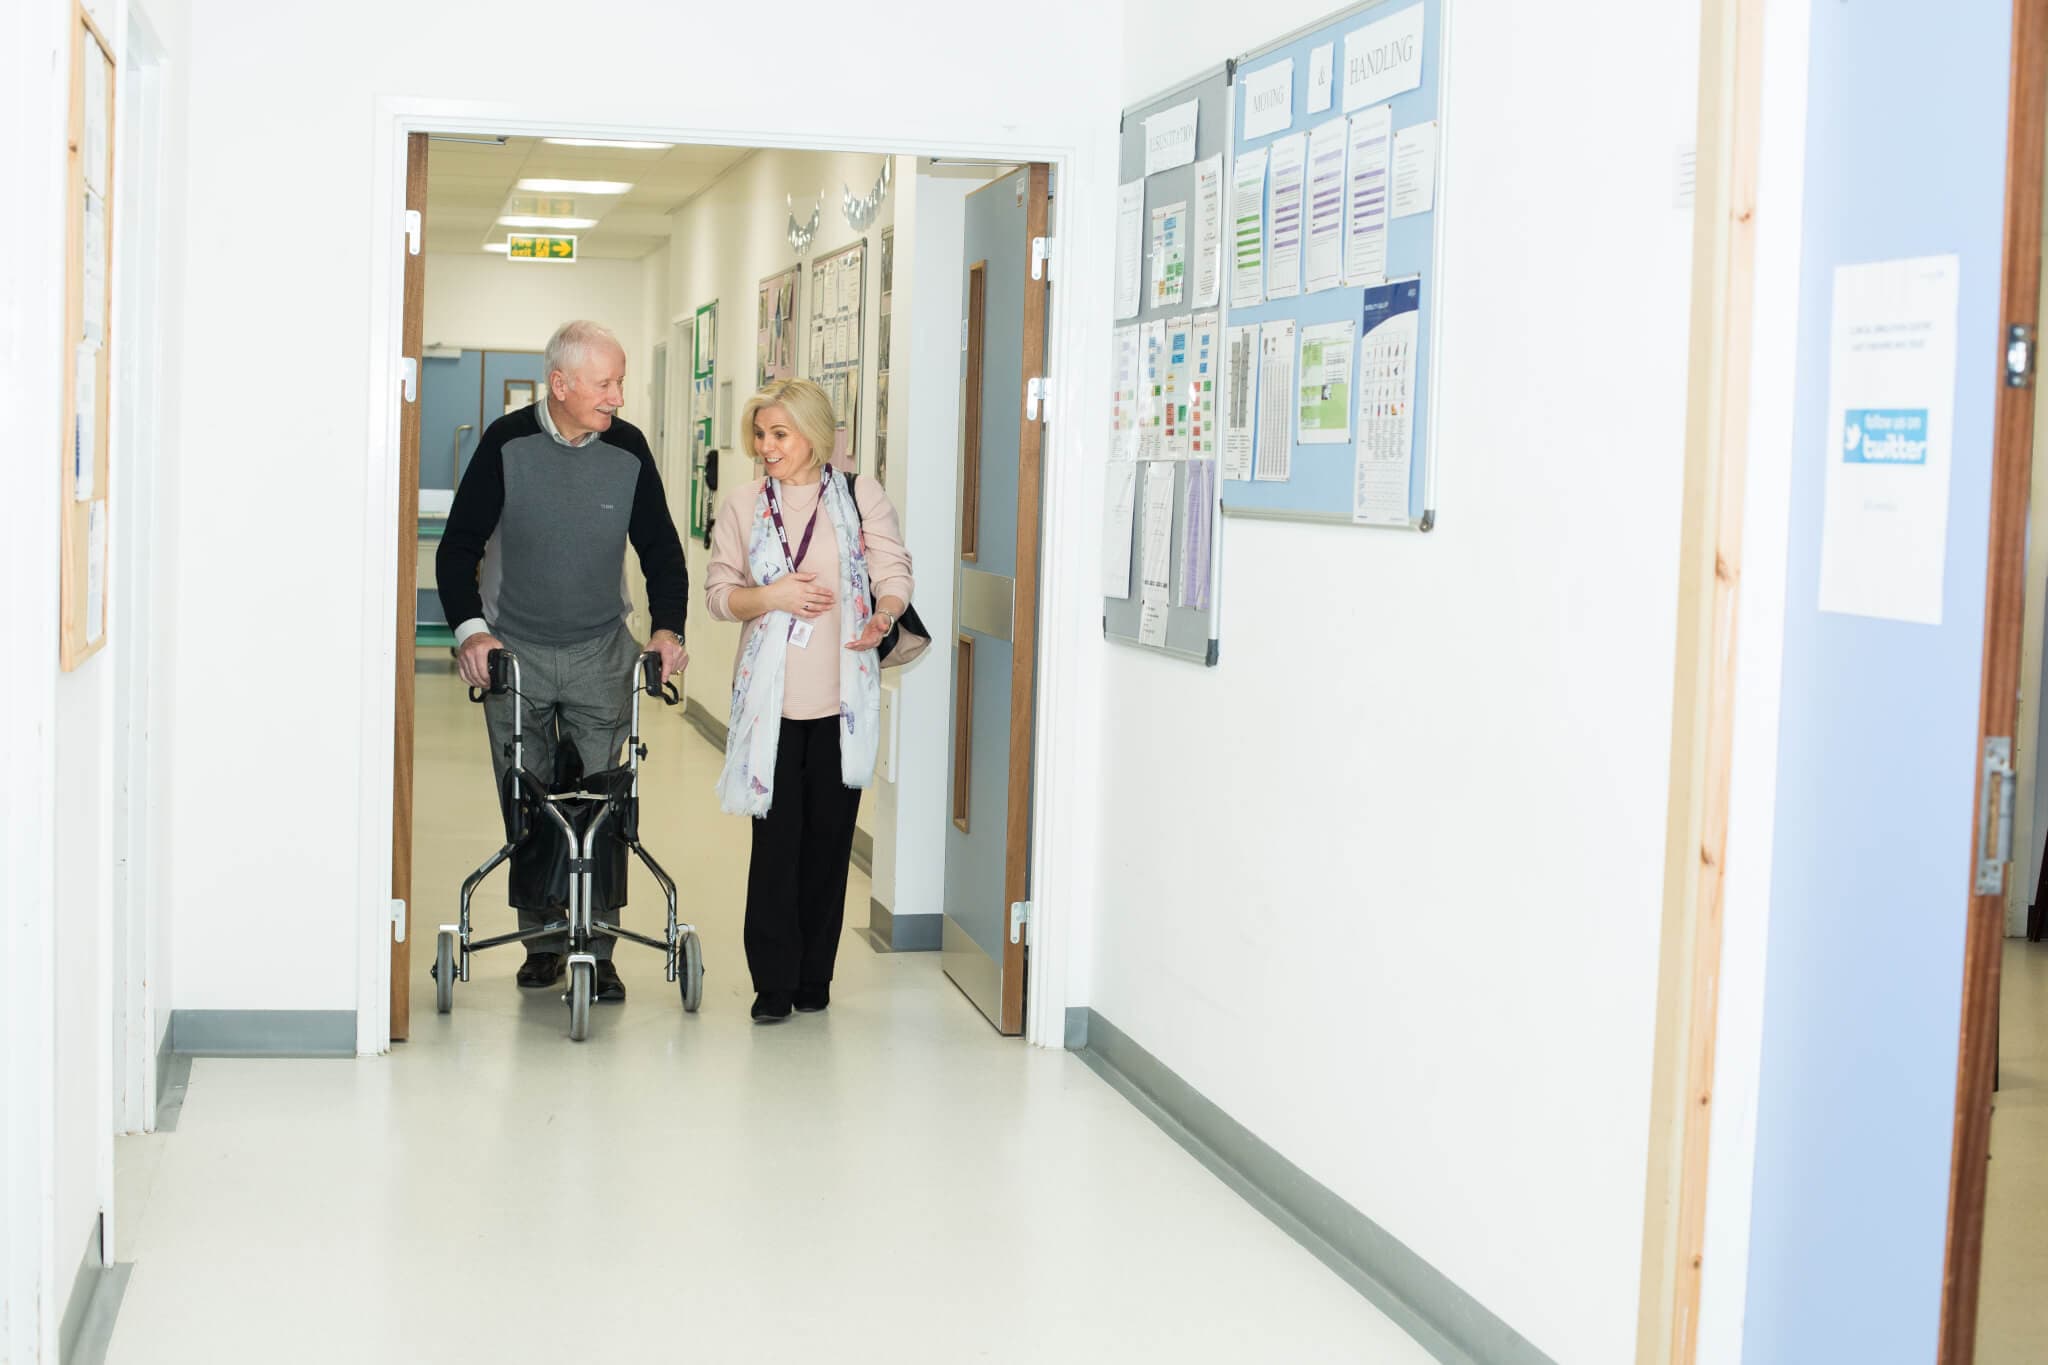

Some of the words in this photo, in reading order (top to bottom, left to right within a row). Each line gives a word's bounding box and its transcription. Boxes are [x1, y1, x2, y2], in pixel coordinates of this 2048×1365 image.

[1252, 85, 1285, 114] MOVING
[1317, 66, 1327, 87] &
[1348, 34, 1413, 86] HANDLING
[511, 237, 532, 247] Fire
[511, 249, 531, 257] exit
[1864, 413, 1891, 430] follow
[1863, 432, 1927, 460] twitter
